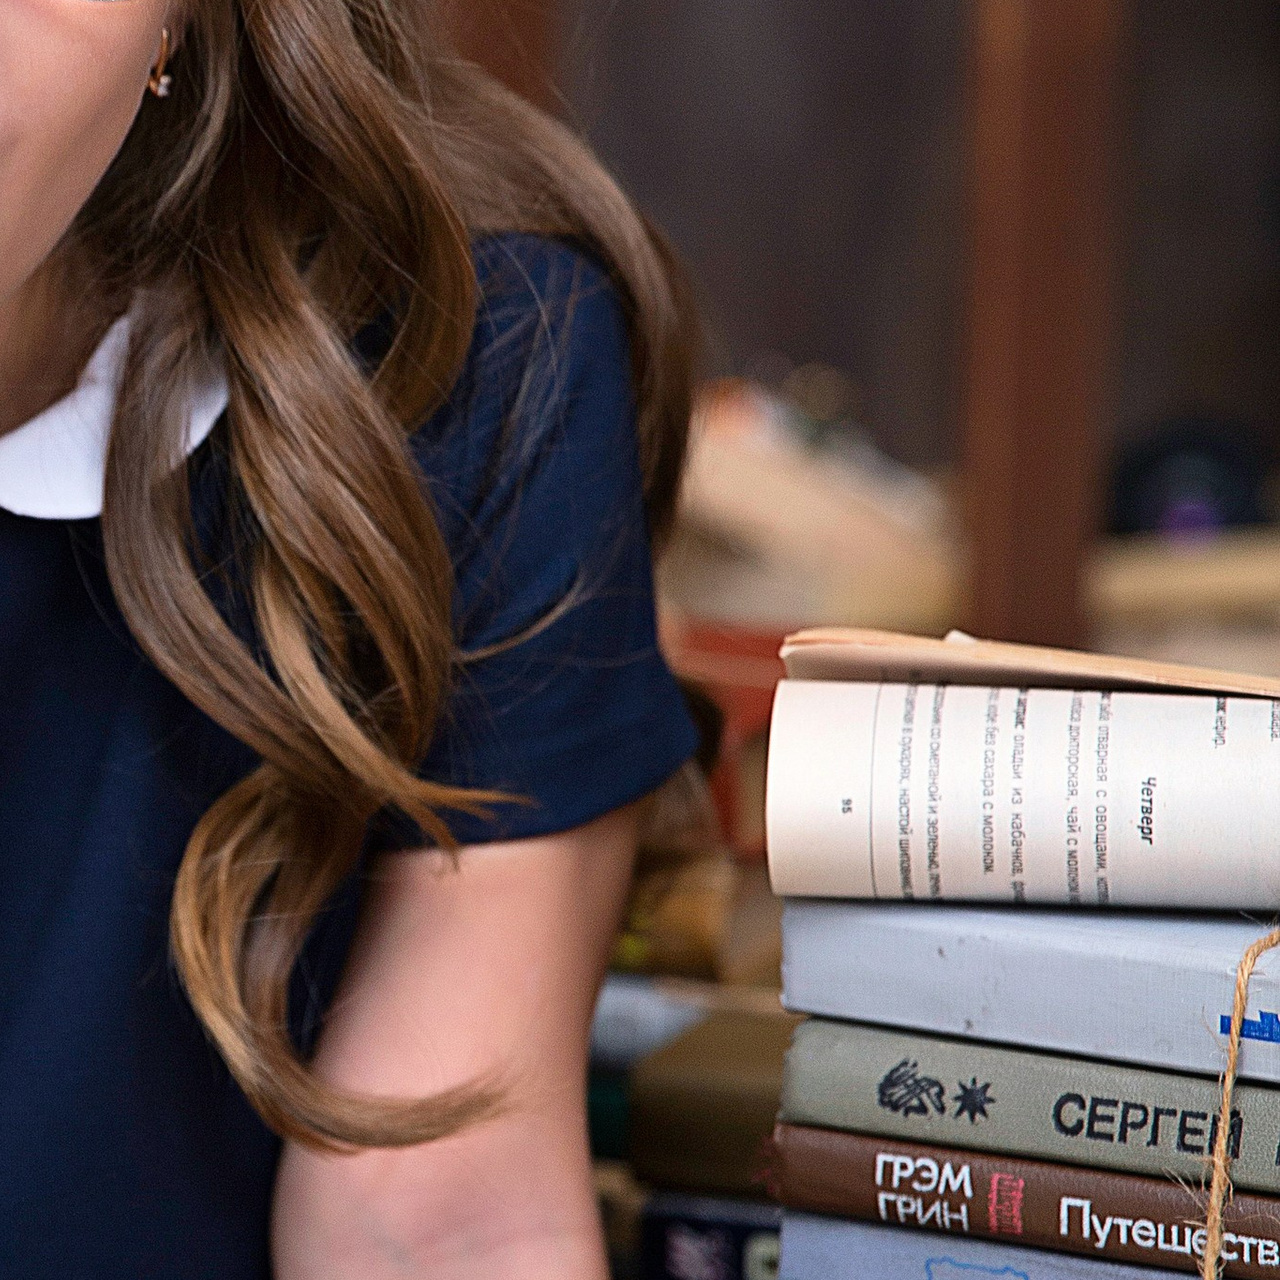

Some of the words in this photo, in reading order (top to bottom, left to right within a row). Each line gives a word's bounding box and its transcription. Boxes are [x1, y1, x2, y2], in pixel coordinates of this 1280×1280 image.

[985, 727, 1000, 745] без
[1012, 735, 1025, 779] оладьи
[1094, 725, 1110, 782] отварная
[898, 736, 913, 783] сухарях,
[927, 742, 941, 801] сметаной
[980, 750, 995, 796] сахара
[1066, 725, 1081, 801] докторская,
[841, 798, 852, 814] 95
[899, 789, 912, 835] настой
[928, 804, 938, 813] и
[983, 802, 993, 810] с
[1011, 788, 1024, 804] из
[1096, 790, 1107, 798] с
[1138, 776, 1156, 845] Четверг
[1066, 807, 1080, 834] чай
[1094, 805, 1108, 872] овощами,
[983, 815, 994, 875] молоком.
[1010, 813, 1025, 876] кабачков,
[1052, 1092, 1243, 1159] СЕРГЕЙ
[875, 1152, 973, 1199] ГРЭМ
[878, 1192, 969, 1231] ГРИН
[1060, 1197, 1280, 1266] Путешеств
